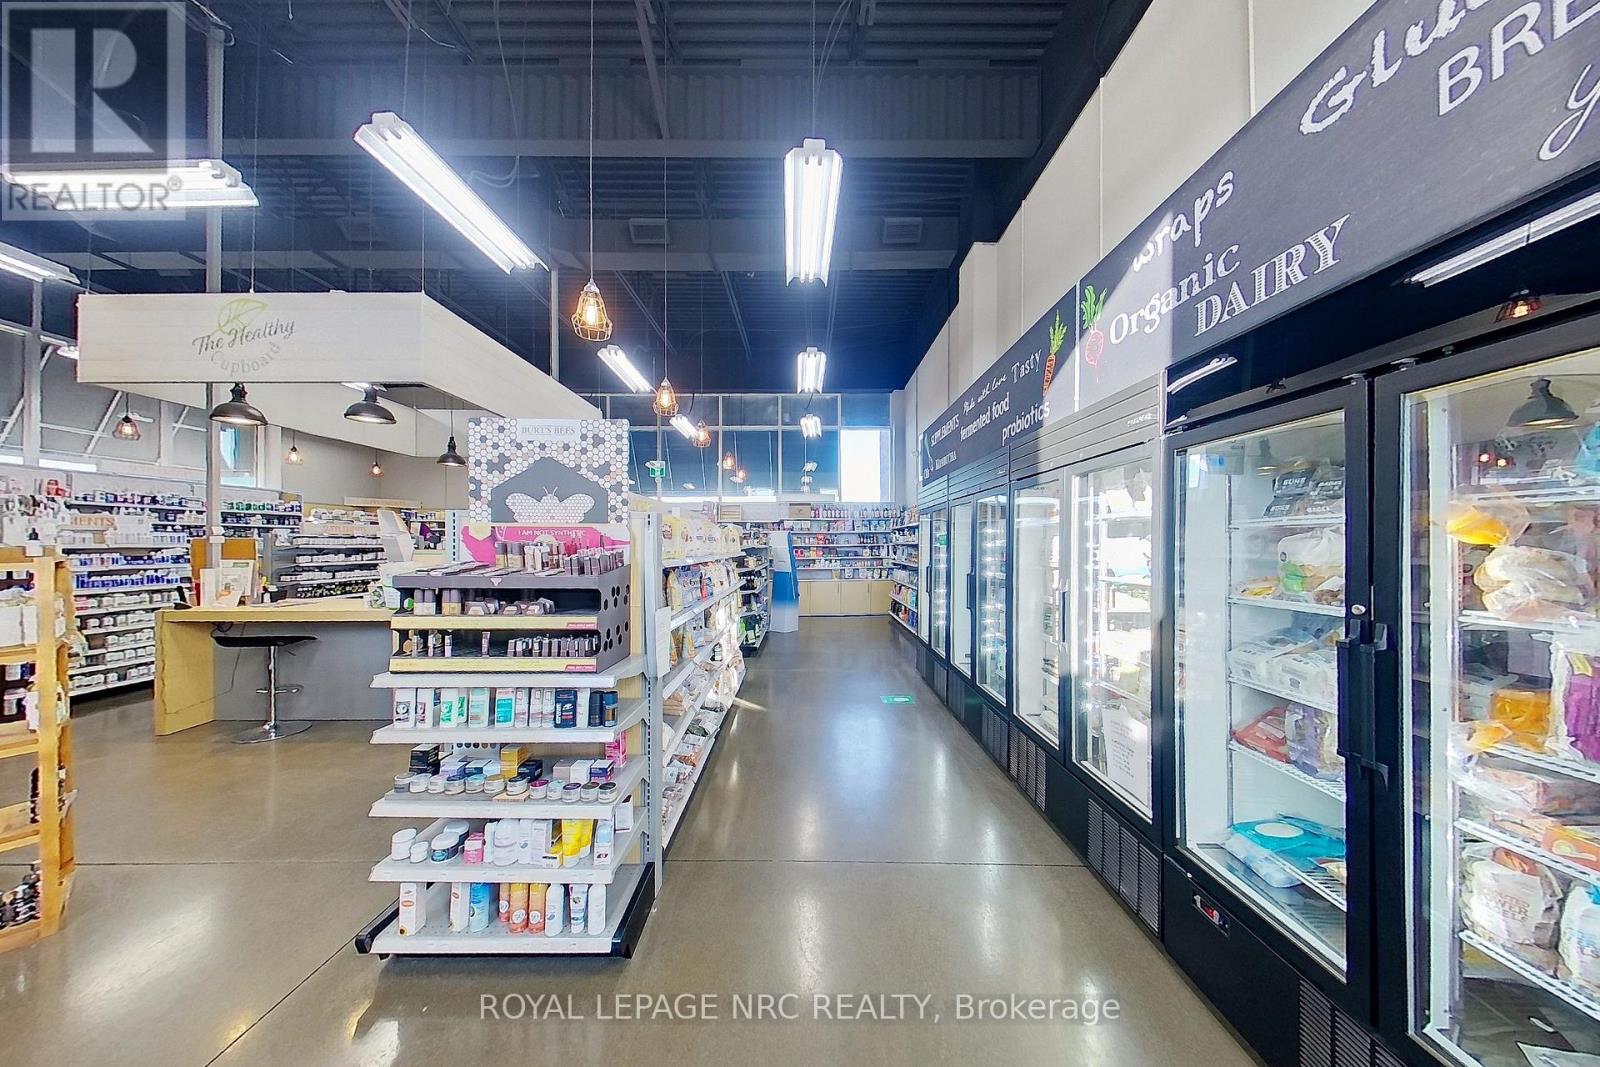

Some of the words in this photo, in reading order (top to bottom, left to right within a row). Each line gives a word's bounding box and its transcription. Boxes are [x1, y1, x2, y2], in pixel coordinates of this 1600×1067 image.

[1133, 170, 1234, 272] wraps
[1109, 244, 1241, 345] Organic
[1193, 214, 1351, 337] DAIRY
[192, 335, 224, 355] The
[228, 319, 295, 348] Healthy
[1011, 348, 1042, 384] Tasty
[960, 406, 991, 442] fermented
[992, 391, 1010, 420] food
[1002, 401, 1050, 447] probiotics
